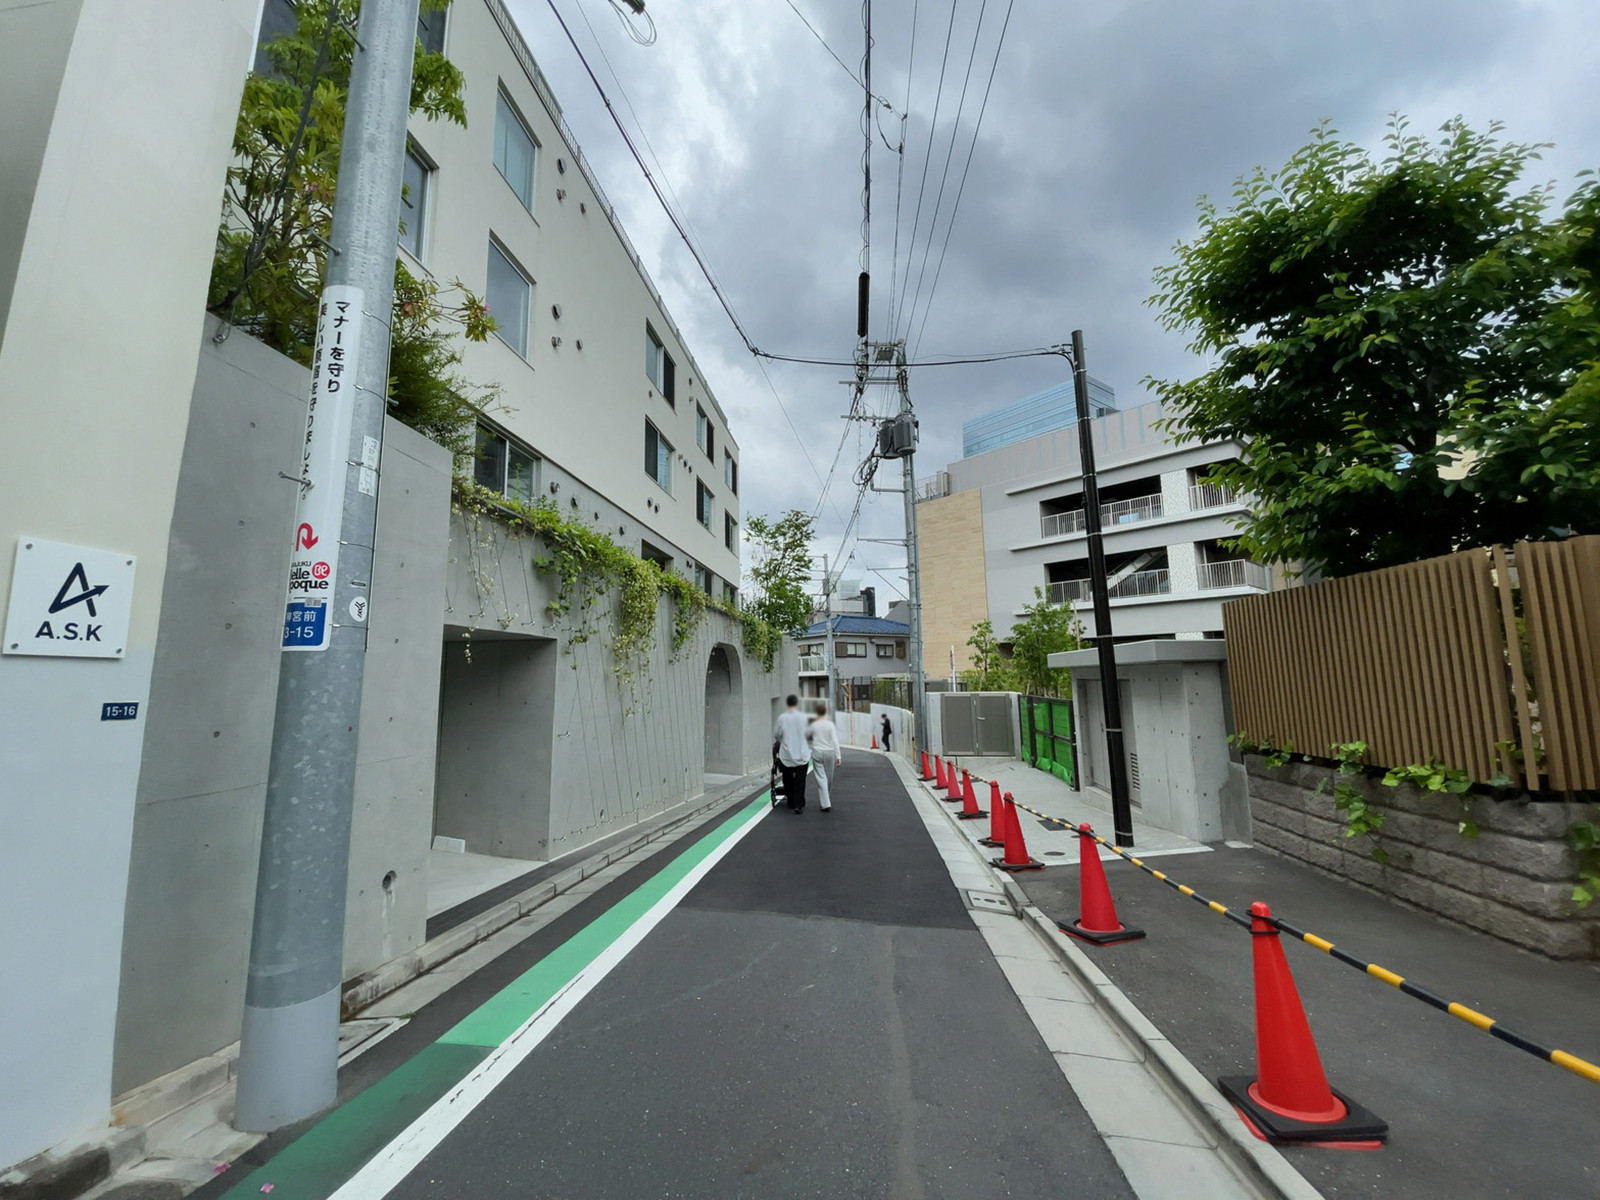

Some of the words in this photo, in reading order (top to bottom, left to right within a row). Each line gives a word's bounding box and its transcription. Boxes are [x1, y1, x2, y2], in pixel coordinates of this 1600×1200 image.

[327, 301, 351, 393] マナーを守り
[290, 568, 310, 580] elle
[35, 620, 103, 642] A.S.K
[105, 705, 136, 717] 15-16
